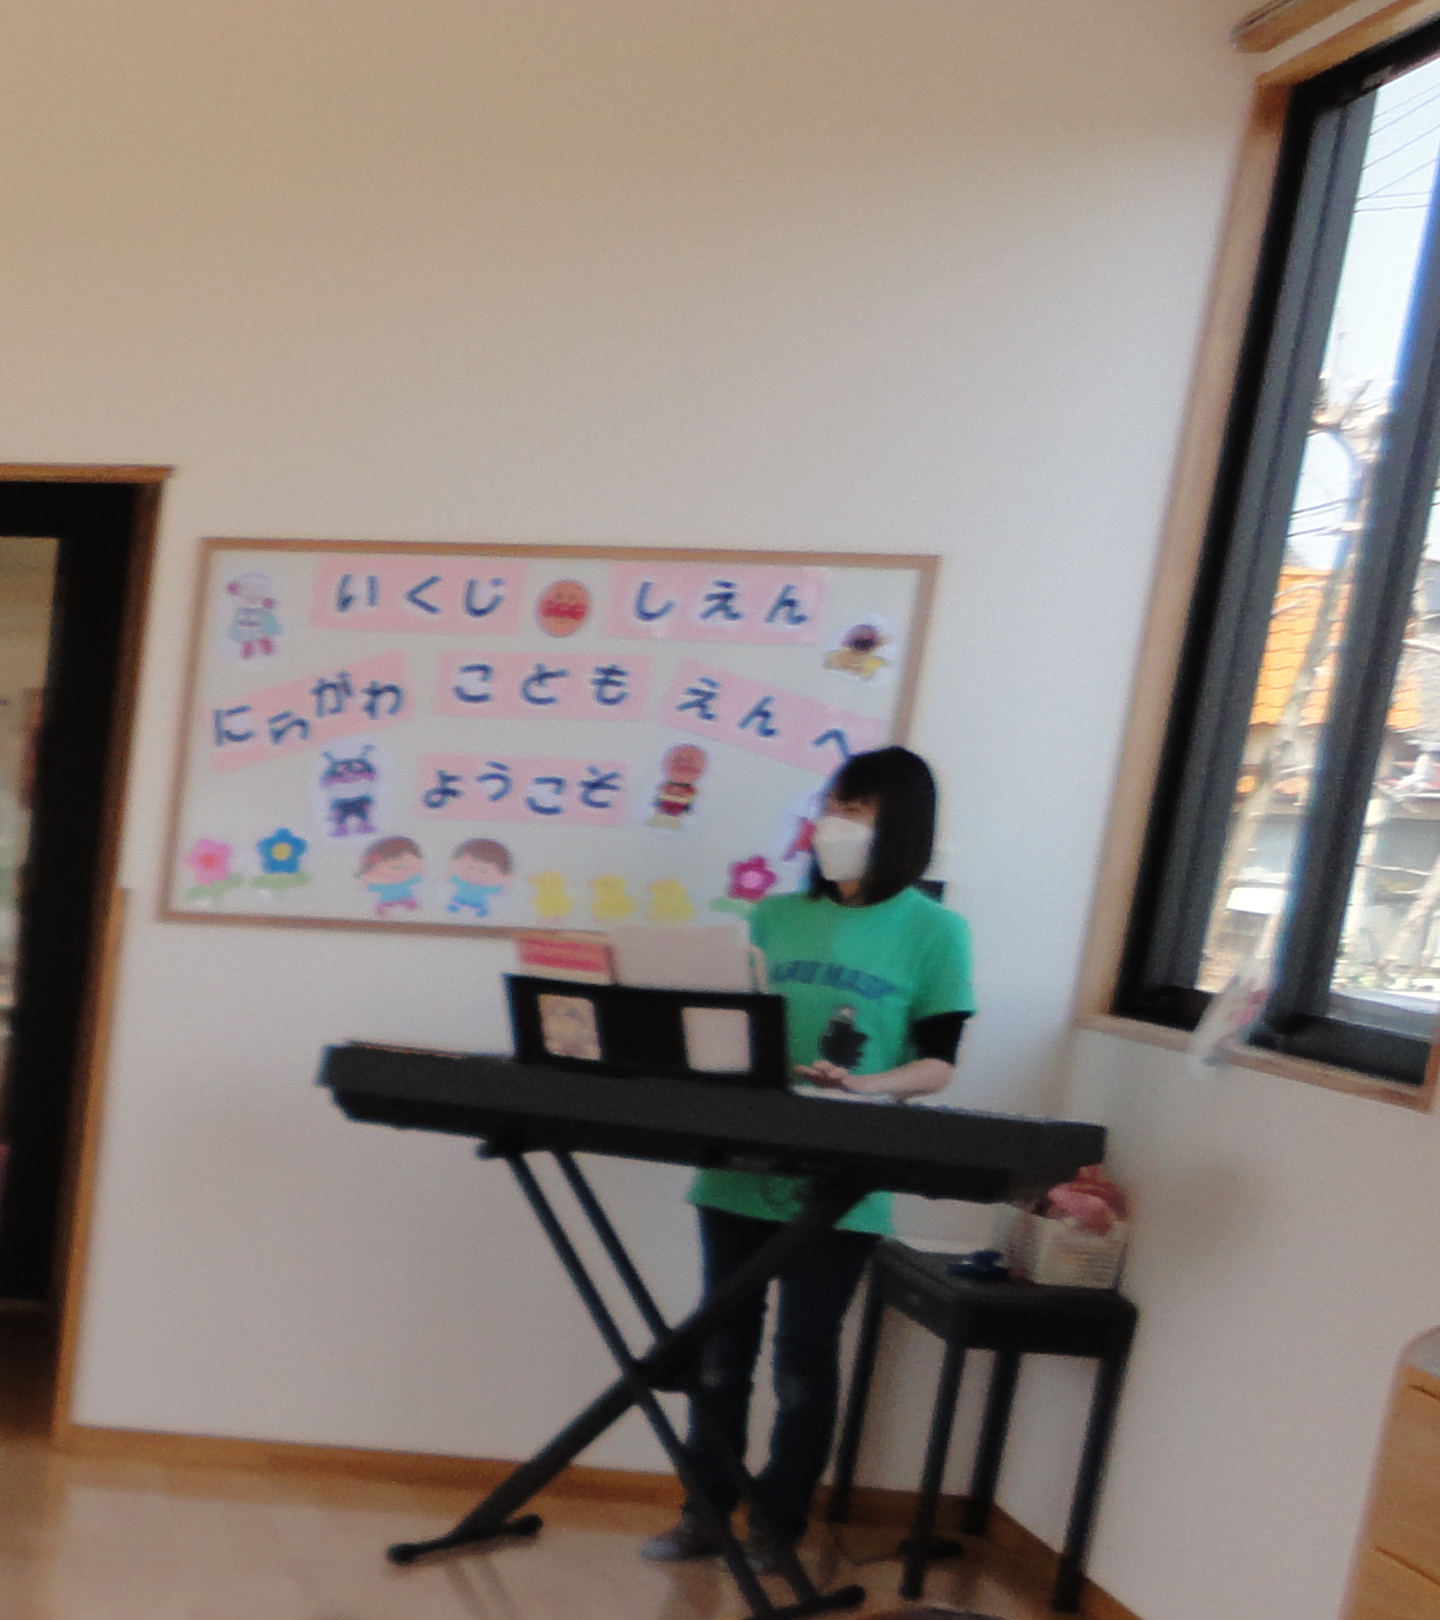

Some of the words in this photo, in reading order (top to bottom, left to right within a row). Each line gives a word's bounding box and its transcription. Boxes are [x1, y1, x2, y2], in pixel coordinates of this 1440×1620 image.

[335, 573, 505, 618] いくじ
[634, 578, 809, 625] しえん
[422, 760, 621, 816] ようこそ
